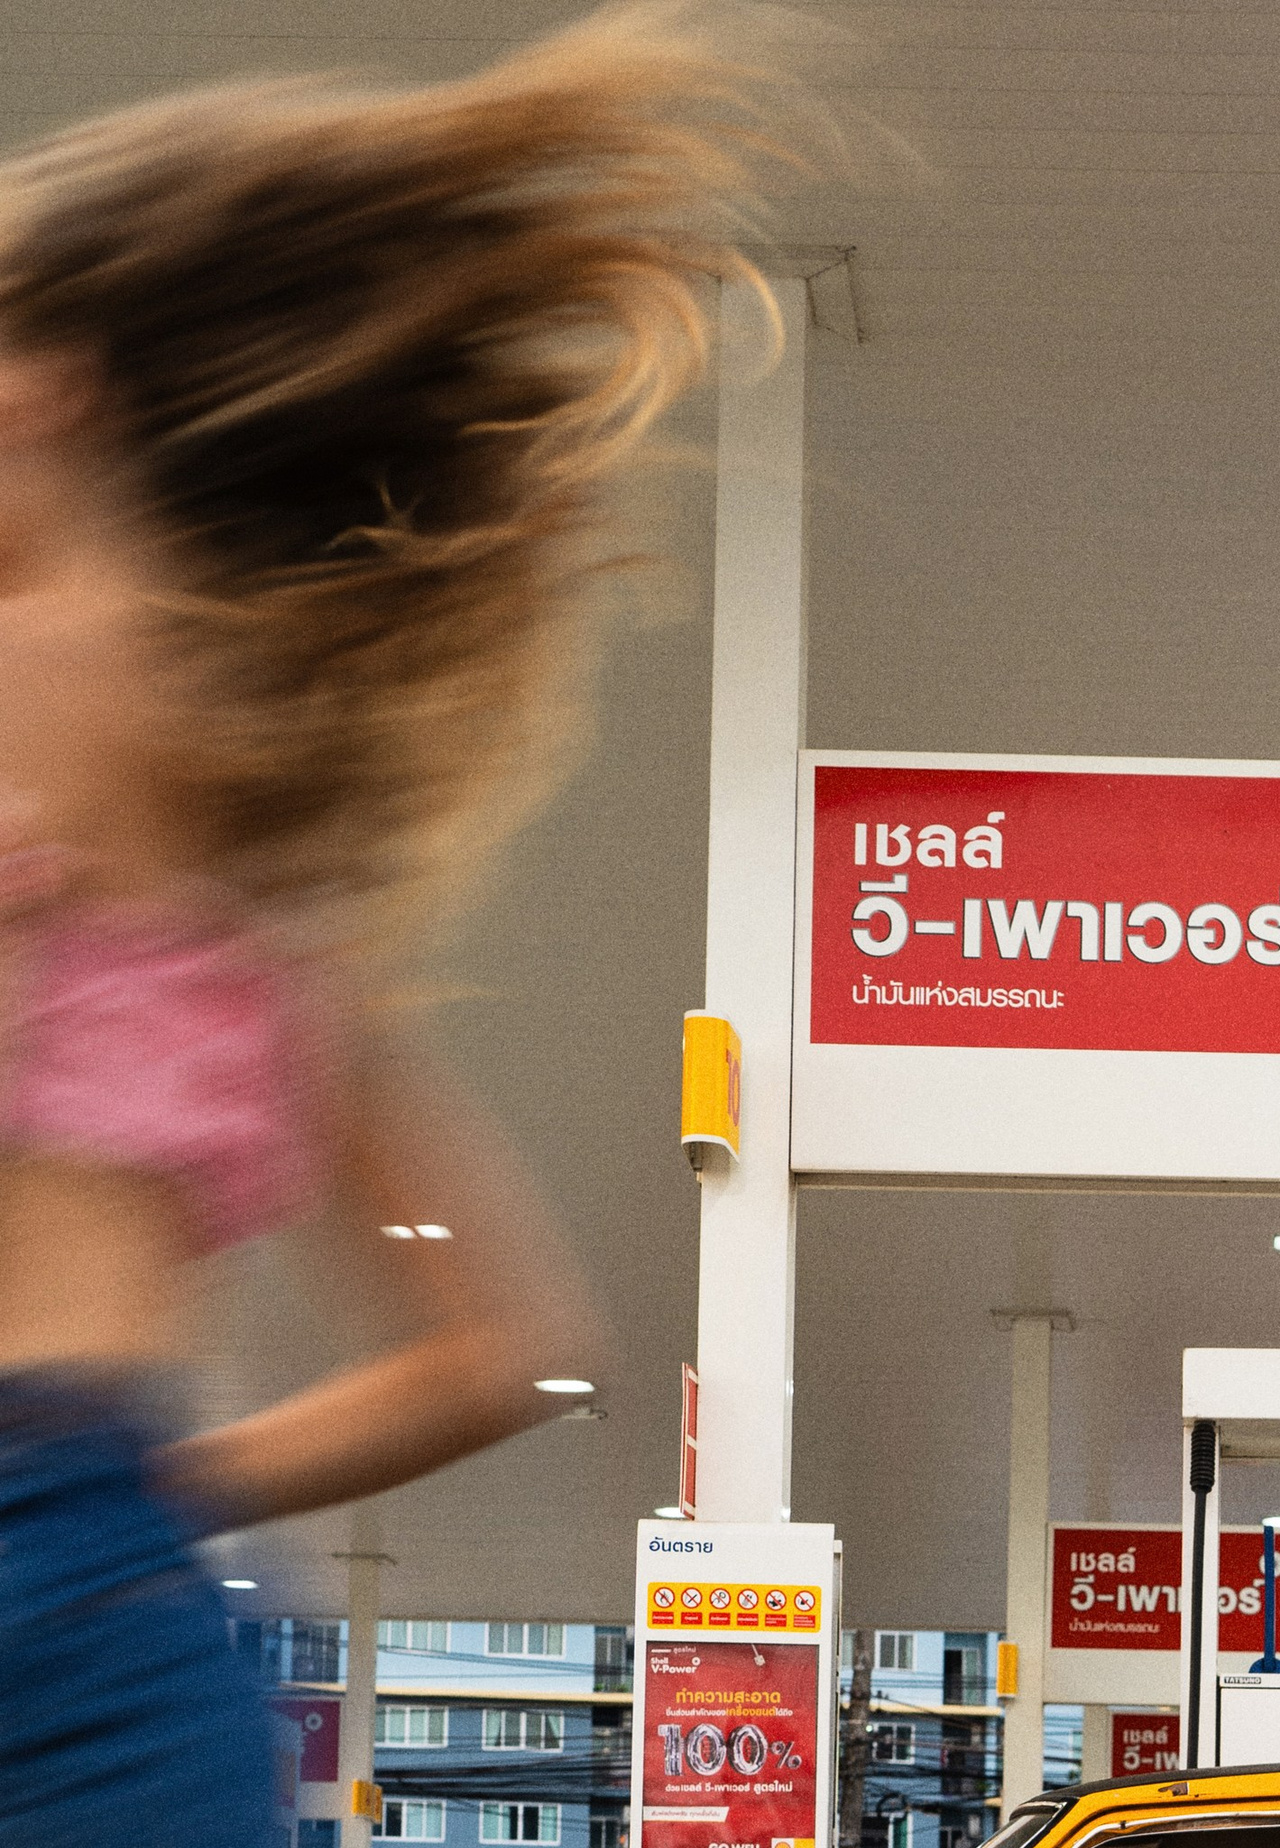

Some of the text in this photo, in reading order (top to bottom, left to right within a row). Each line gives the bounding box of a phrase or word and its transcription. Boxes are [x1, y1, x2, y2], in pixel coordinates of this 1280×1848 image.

[854, 811, 1005, 869] เชลล์
[852, 974, 1064, 1009] น้ำมันแห่งสมรรถนะ
[649, 1536, 713, 1554] อันตราย
[1070, 1547, 1136, 1574] เชลล์
[651, 1664, 697, 1674] V-Power
[675, 1687, 781, 1704] ทำความสะอาด
[1123, 1726, 1169, 1744] เชลล์
[657, 1723, 802, 1776] 100%
[753, 1780, 793, 1795] สูตรใหม่
